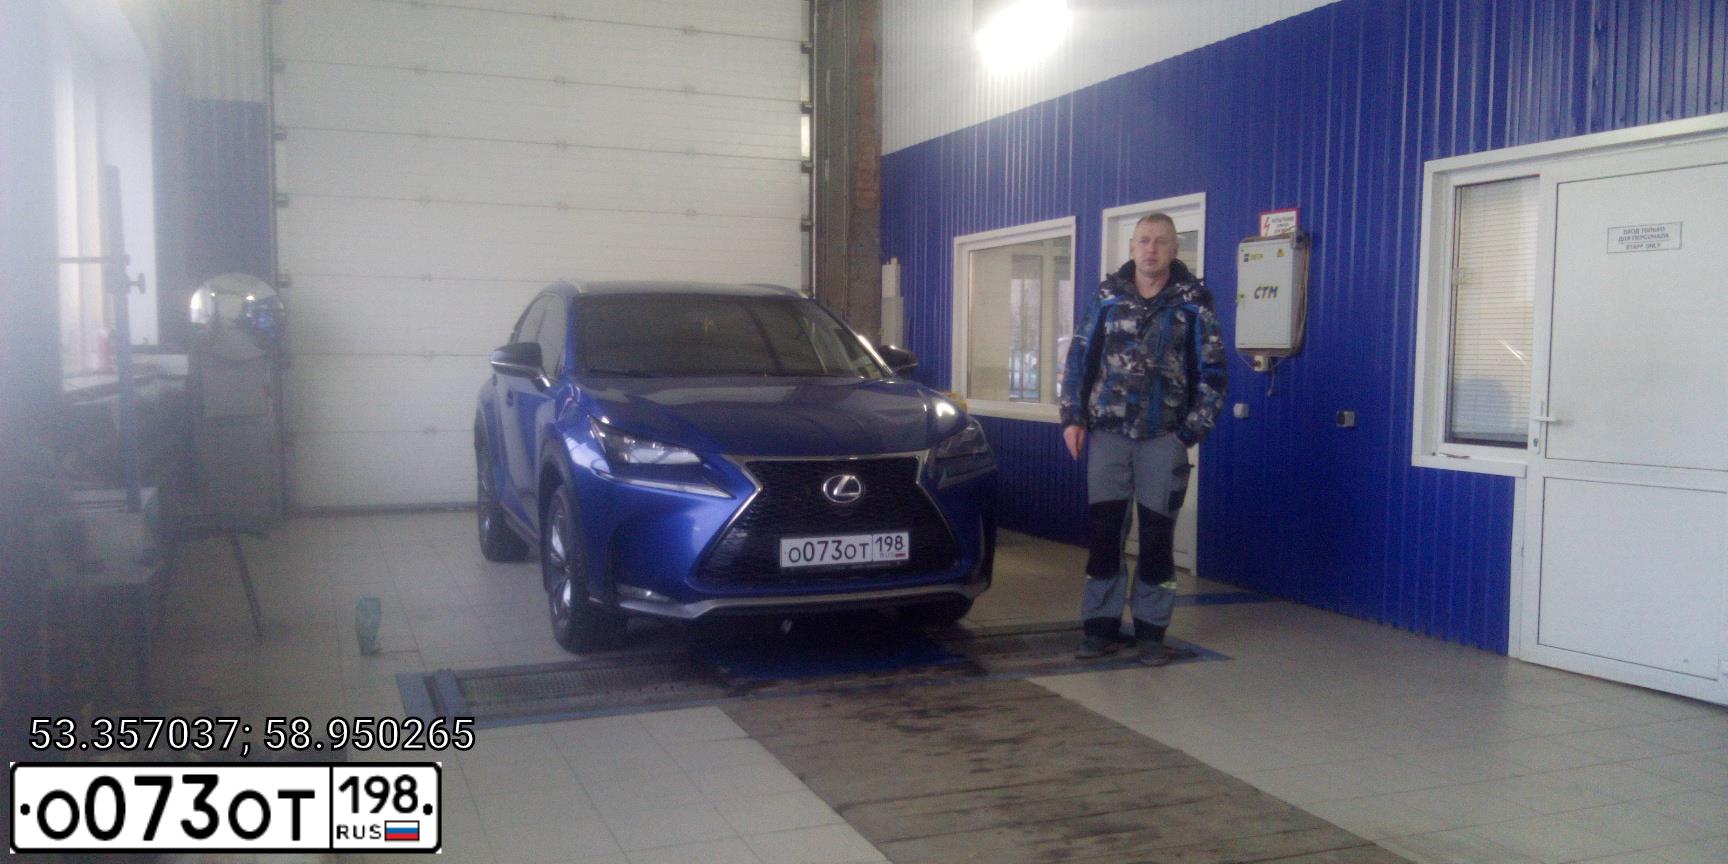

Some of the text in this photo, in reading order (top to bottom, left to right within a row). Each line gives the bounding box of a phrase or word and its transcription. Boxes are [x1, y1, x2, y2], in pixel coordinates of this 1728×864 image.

[1254, 285, 1279, 299] СТМ
[788, 535, 904, 563] О073ОТ 198
